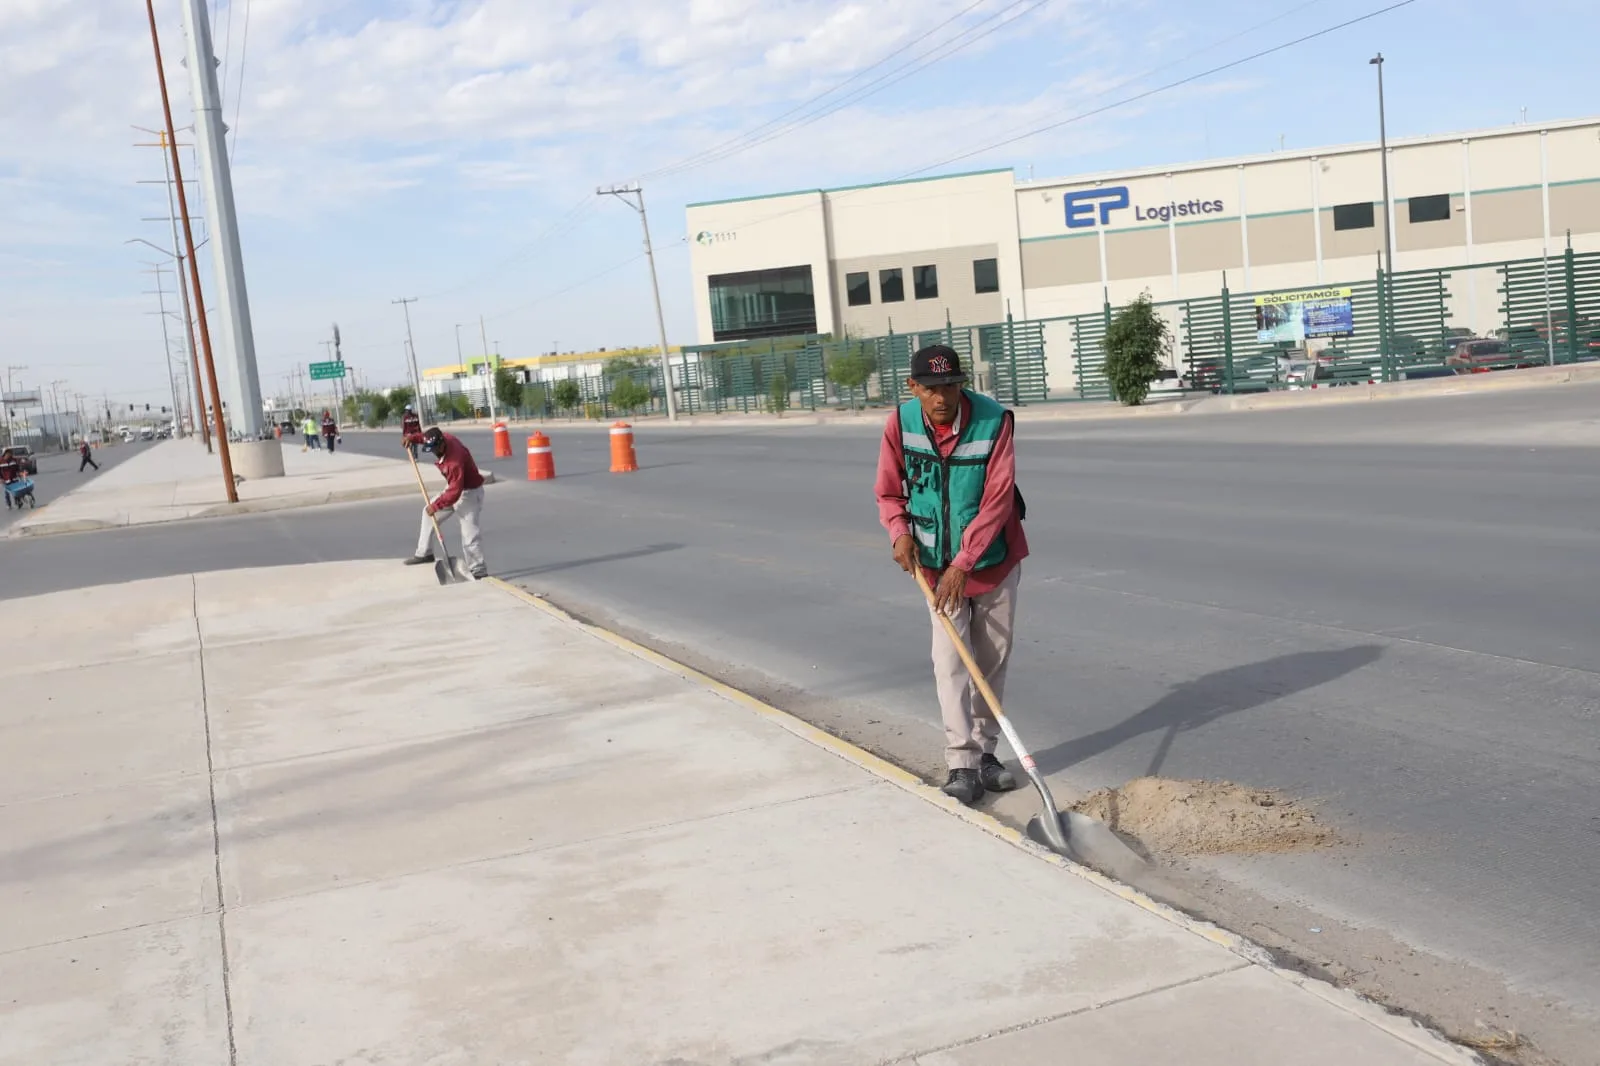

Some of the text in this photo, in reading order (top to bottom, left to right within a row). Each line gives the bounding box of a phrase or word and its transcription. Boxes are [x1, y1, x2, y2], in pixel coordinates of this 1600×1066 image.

[1063, 186, 1224, 229] EP Logistics
[1263, 289, 1341, 304] SOLICITAMOS
